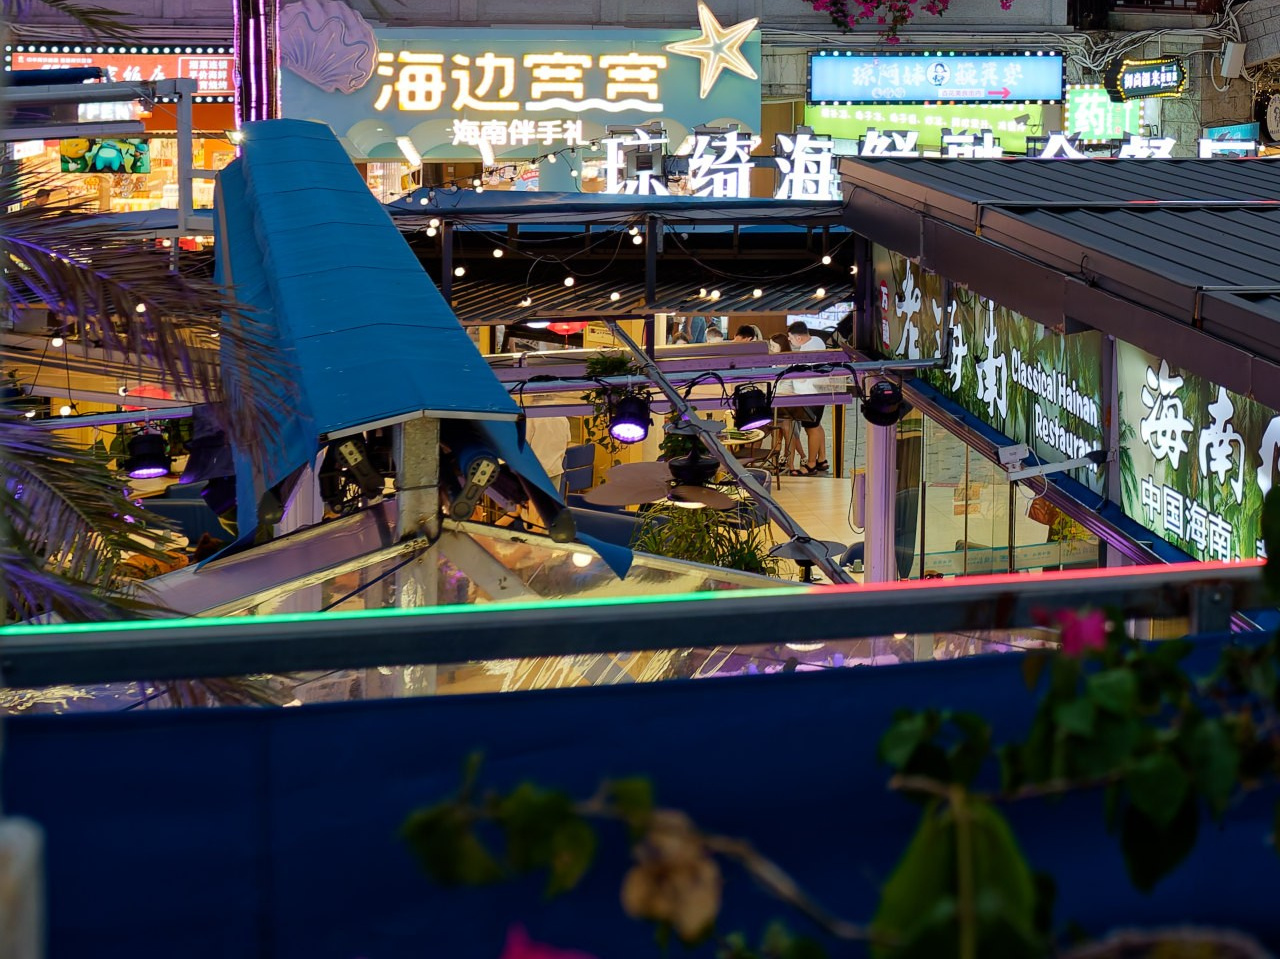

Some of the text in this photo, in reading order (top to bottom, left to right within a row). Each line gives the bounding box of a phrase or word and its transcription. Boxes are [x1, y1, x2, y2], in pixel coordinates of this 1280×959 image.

[451, 119, 590, 146] 海南伴手礼
[1074, 91, 1107, 135] 药
[1011, 347, 1098, 428] Classical Hainan
